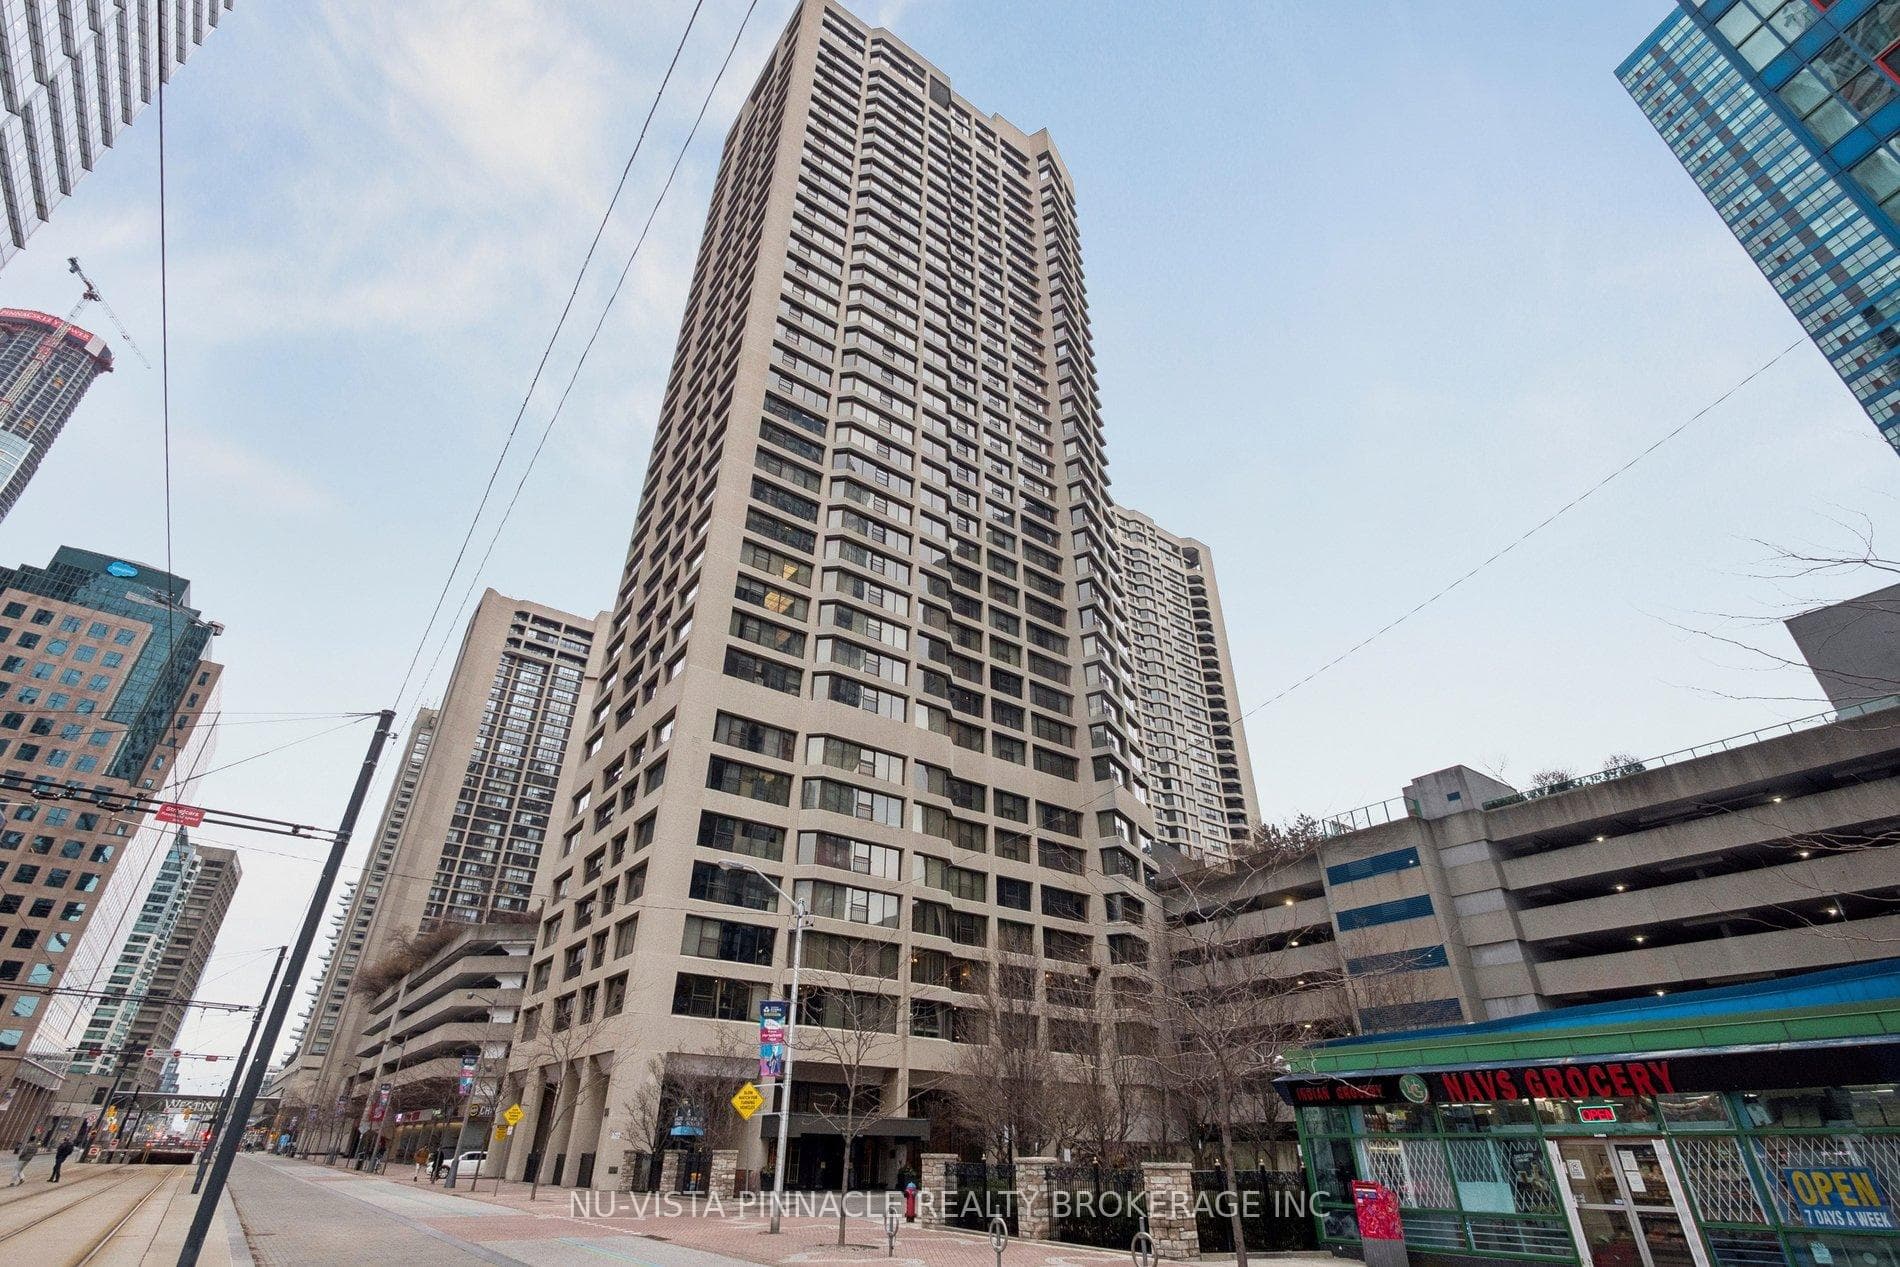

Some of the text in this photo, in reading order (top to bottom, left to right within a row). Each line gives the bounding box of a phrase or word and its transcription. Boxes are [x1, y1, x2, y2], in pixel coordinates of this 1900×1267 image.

[1442, 1062, 1674, 1102] NAVS GROCERY
[1296, 1087, 1330, 1101] INDIAN
[1581, 1108, 1614, 1120] OPEN
[1792, 1170, 1881, 1207] OPEN
[1804, 1210, 1892, 1227] 7 DAYS A WEEK
